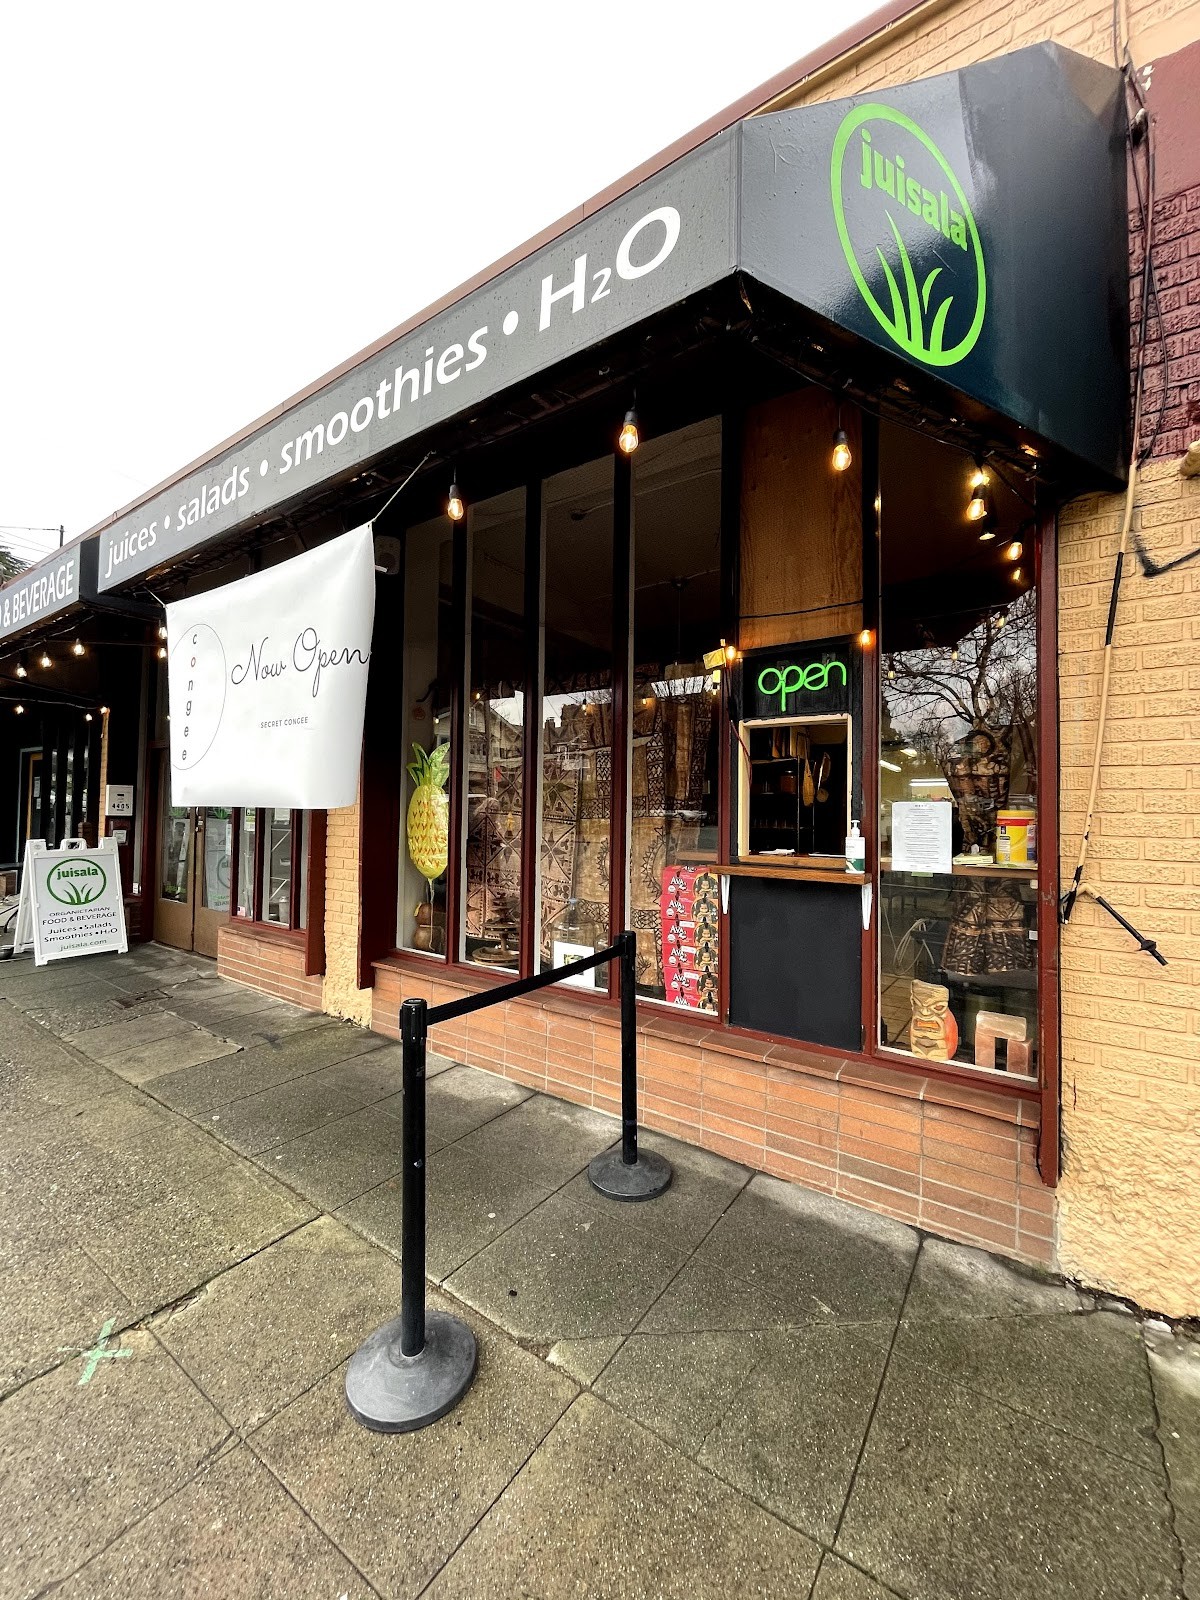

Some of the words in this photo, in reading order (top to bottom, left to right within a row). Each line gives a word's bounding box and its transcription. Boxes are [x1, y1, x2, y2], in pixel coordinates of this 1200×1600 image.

[860, 128, 968, 252] juisala
[104, 521, 158, 579] juices
[176, 464, 250, 532] salads
[278, 325, 488, 475] smoothies
[538, 206, 682, 332] H2O
[3, 598, 11, 628] &
[12, 560, 75, 624] BEVERAGE
[231, 636, 287, 685] Now
[293, 627, 372, 698] Open
[757, 661, 847, 712] open
[260, 719, 283, 729] SECRET
[283, 716, 309, 726] CONGEE
[56, 867, 99, 880] juisala
[42, 917, 68, 926] FOOD
[76, 911, 117, 922] BEVERAGE
[49, 906, 111, 917] ORGANICTARIAN
[47, 927, 77, 935] Juices
[84, 922, 112, 930] Salads
[43, 932, 93, 943] Smoothies
[58, 939, 107, 952] juisala.com
